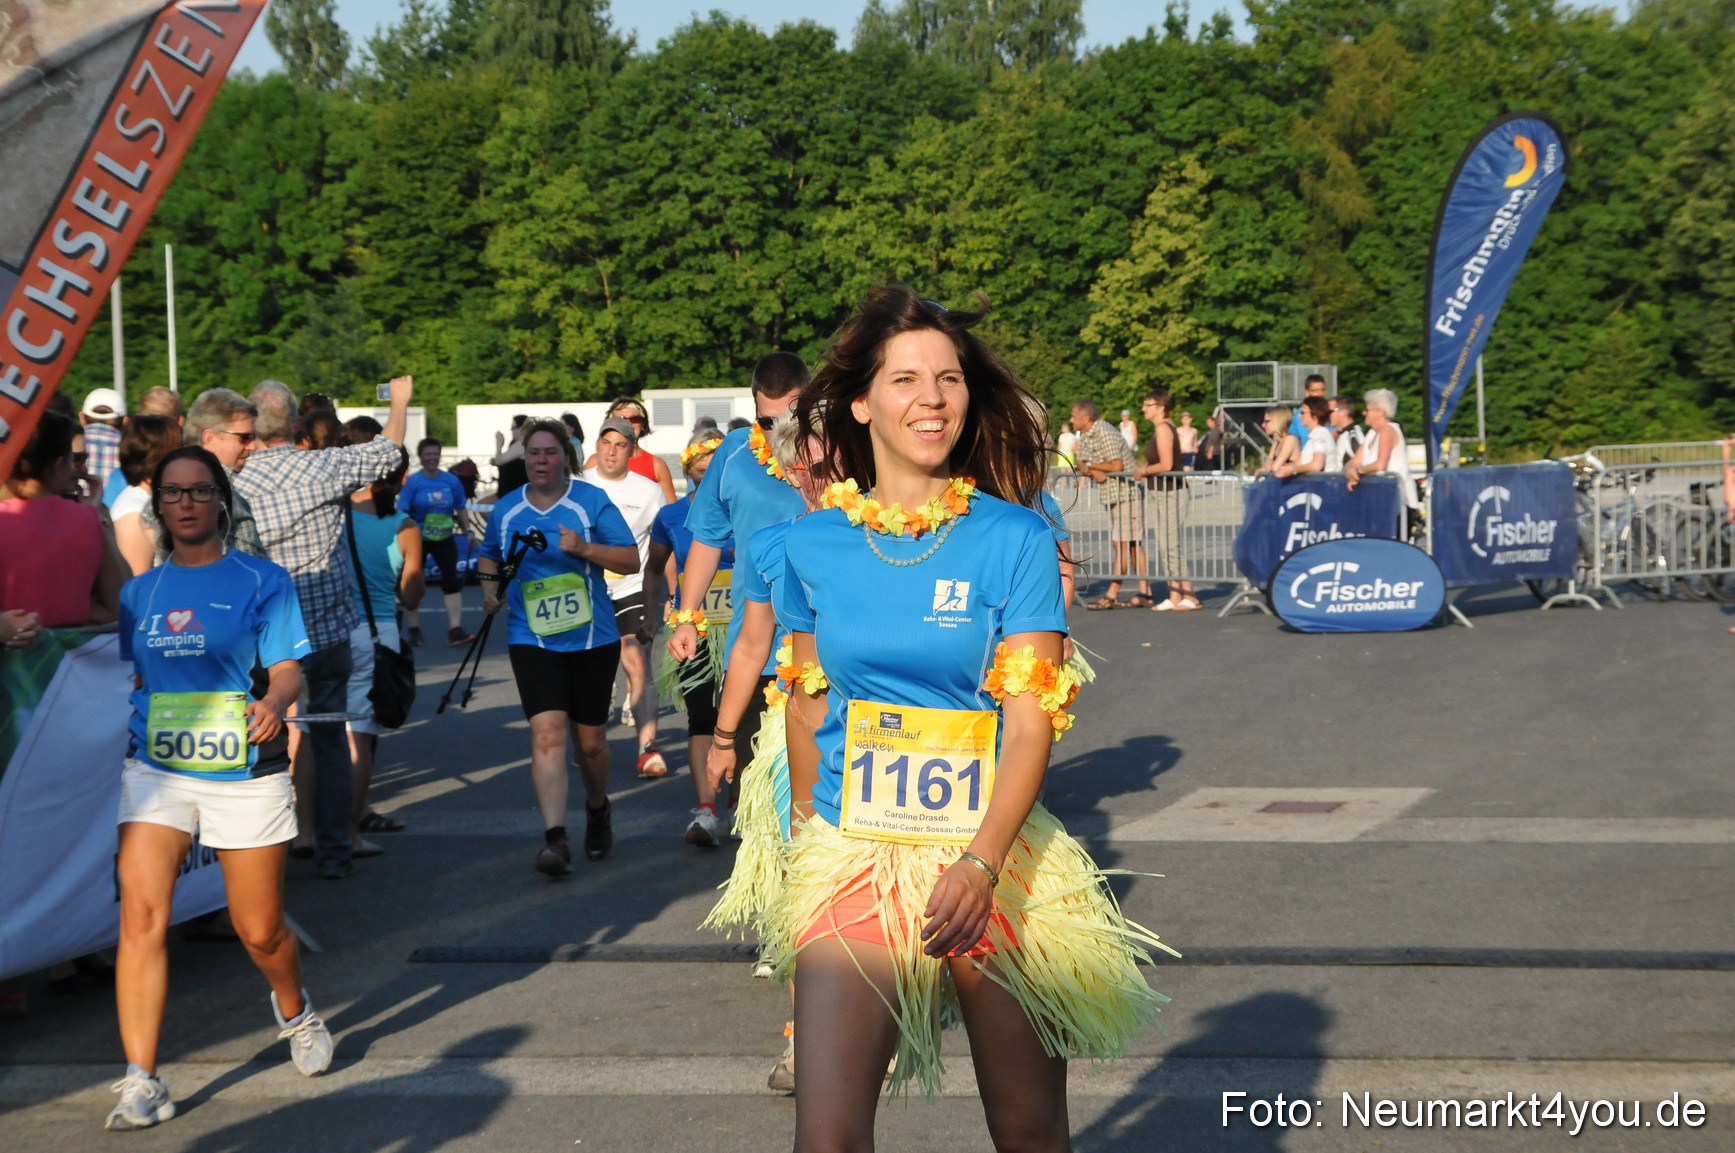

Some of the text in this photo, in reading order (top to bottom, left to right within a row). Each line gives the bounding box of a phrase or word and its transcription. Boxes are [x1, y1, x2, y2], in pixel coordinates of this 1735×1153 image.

[0, 0, 239, 441] ECHSELSZEN
[1434, 188, 1526, 337] Frischmann
[1284, 521, 1366, 552] Fisch
[1485, 513, 1558, 547] Fischer
[1491, 548, 1552, 565] AUTOMOBILE
[1314, 578, 1424, 602] Fischer
[535, 592, 580, 621] 475
[1325, 599, 1416, 613] AUTOMOBILE
[146, 632, 206, 649] camping
[869, 725, 922, 740] firmenlauf
[154, 731, 240, 761] 5050
[854, 739, 895, 753] walken
[851, 750, 981, 811] 1161
[882, 821, 924, 833] Vital-Center
[926, 825, 954, 834] Sossau
[884, 810, 949, 822] Caroline Drasdo
